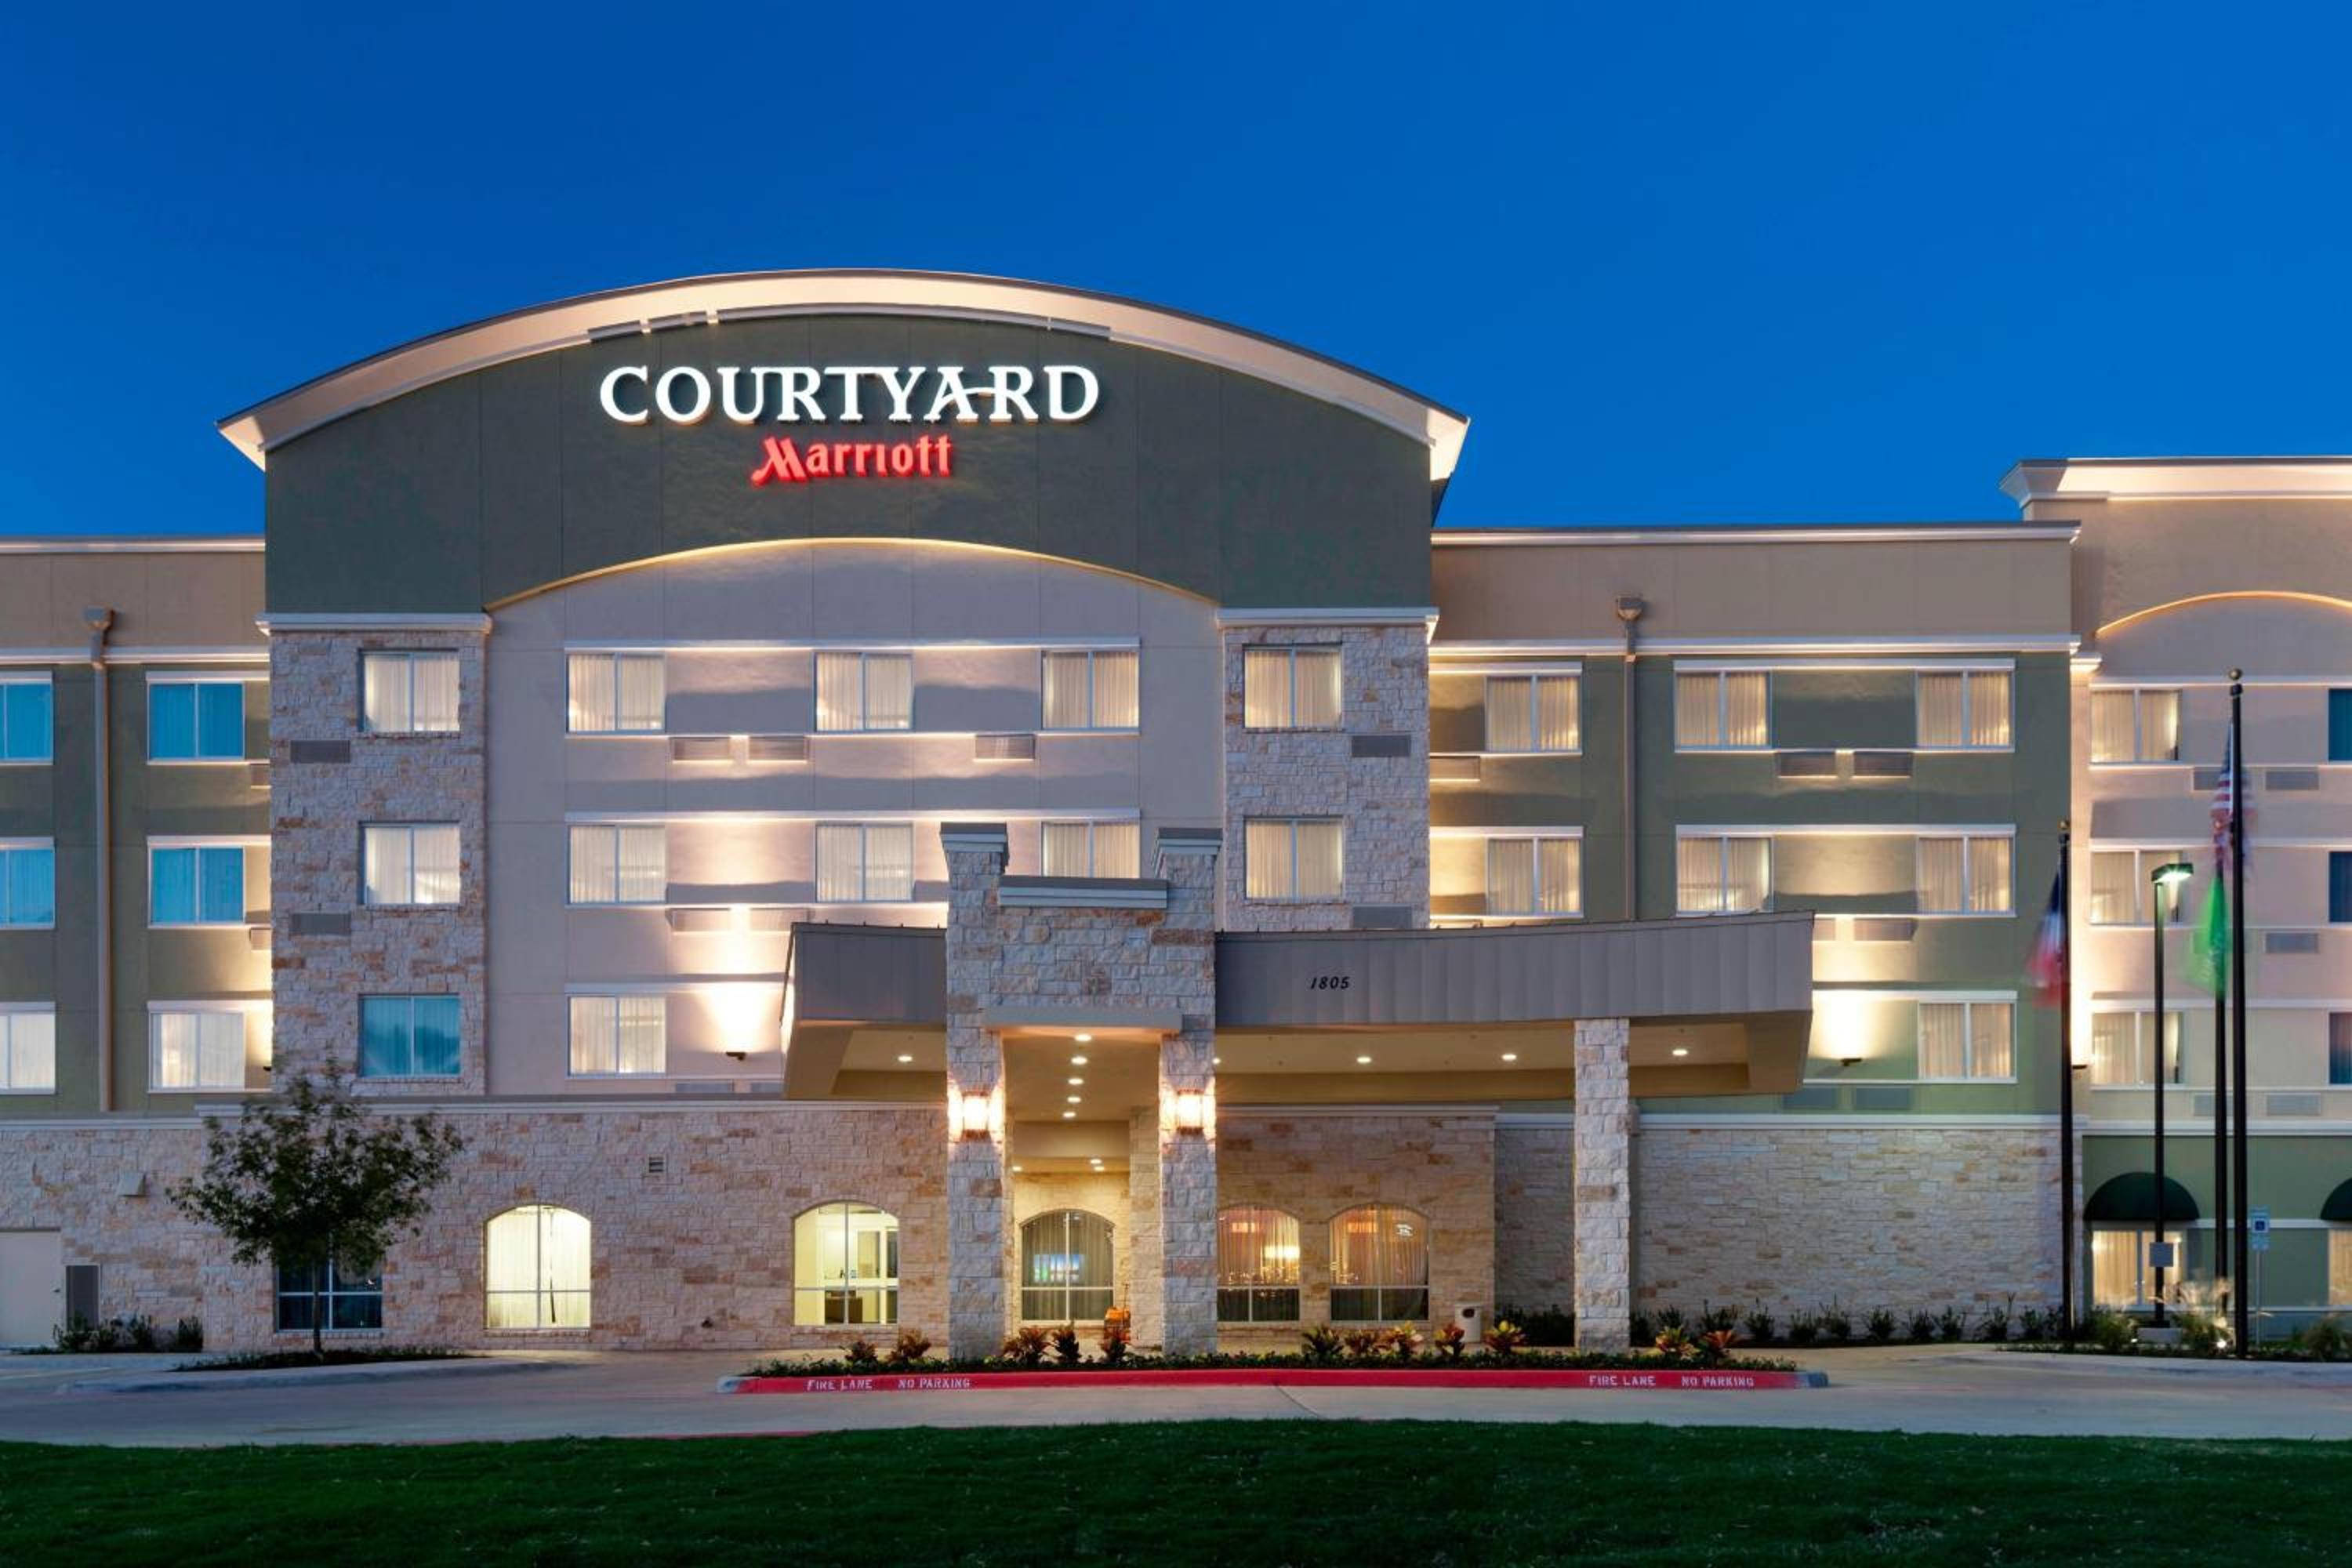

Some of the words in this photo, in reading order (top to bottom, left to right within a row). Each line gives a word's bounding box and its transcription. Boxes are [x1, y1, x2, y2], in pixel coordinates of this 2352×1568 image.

[599, 365, 1100, 424] COURTYARD
[750, 434, 953, 485] Marriott
[1310, 976, 1350, 989] 1805
[807, 1379, 836, 1391] FIRE
[840, 1379, 873, 1391] LANE
[898, 1379, 915, 1388] NO
[920, 1378, 971, 1388] PARKING
[1589, 1375, 1618, 1386] FIRE
[1623, 1375, 1656, 1386] LANE
[1681, 1375, 1697, 1386] NO
[1703, 1375, 1755, 1387] PARKING
